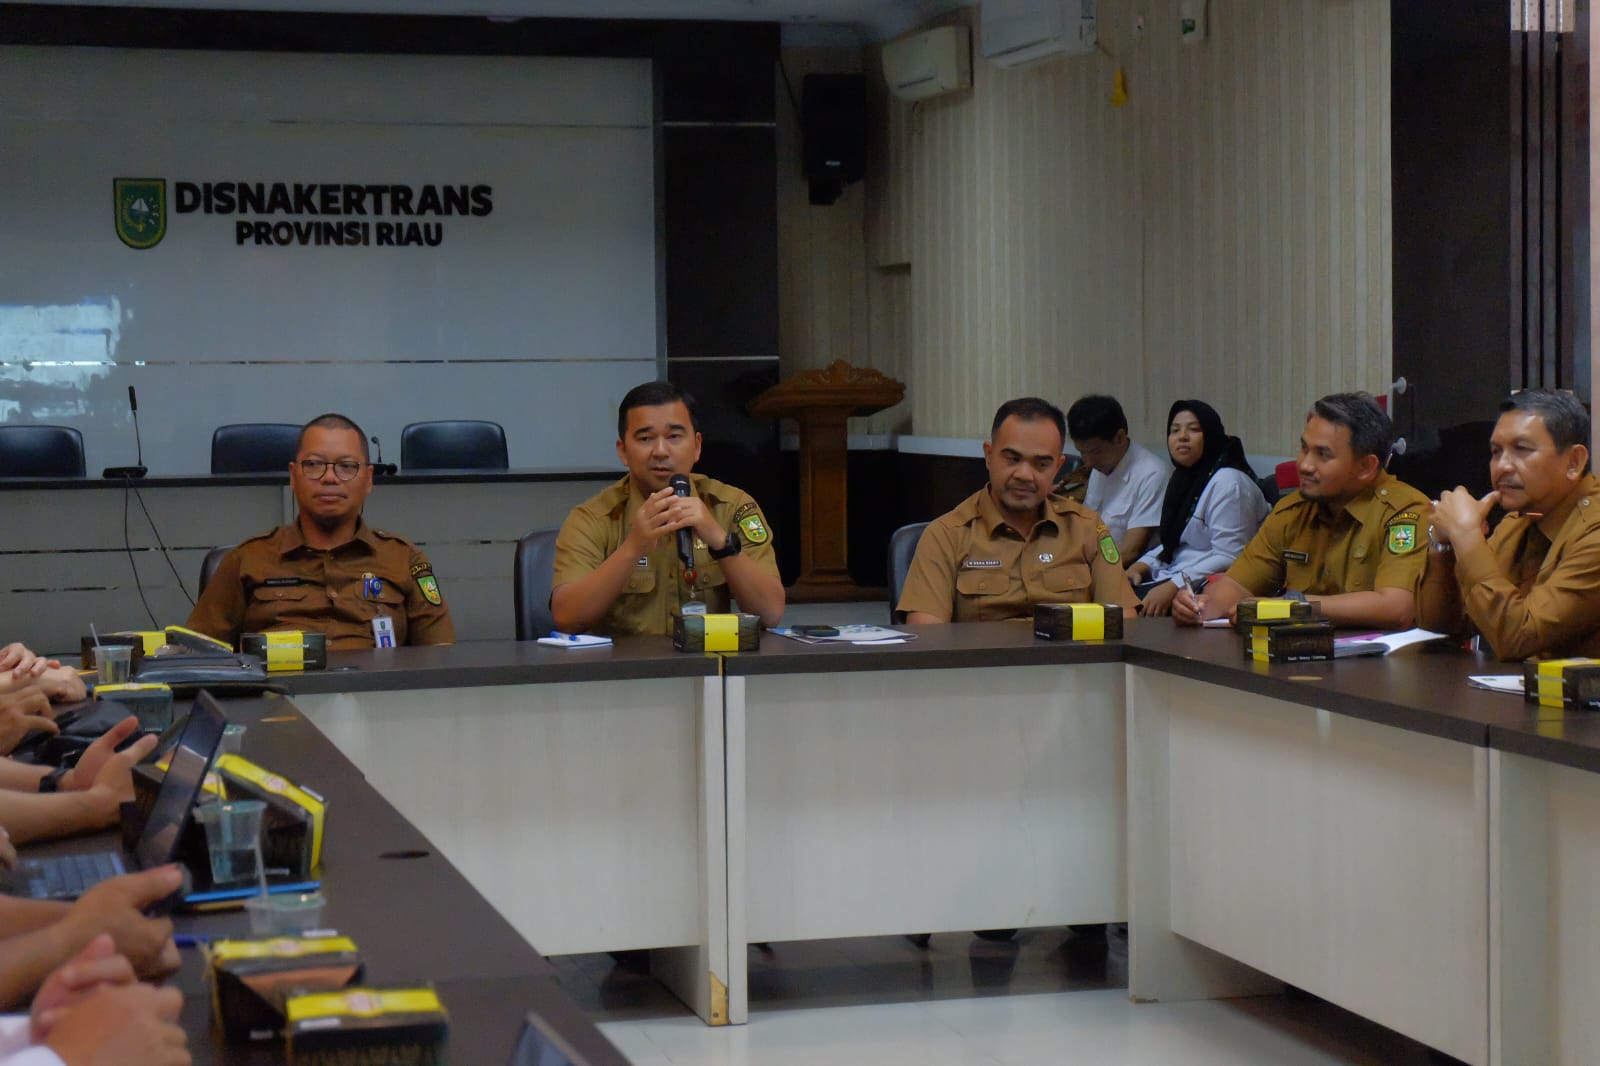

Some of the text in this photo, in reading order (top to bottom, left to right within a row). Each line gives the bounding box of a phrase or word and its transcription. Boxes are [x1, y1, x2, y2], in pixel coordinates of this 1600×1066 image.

[174, 181, 493, 217] DISNAKERTRANS
[236, 221, 442, 247] PROVINSI RIAU
